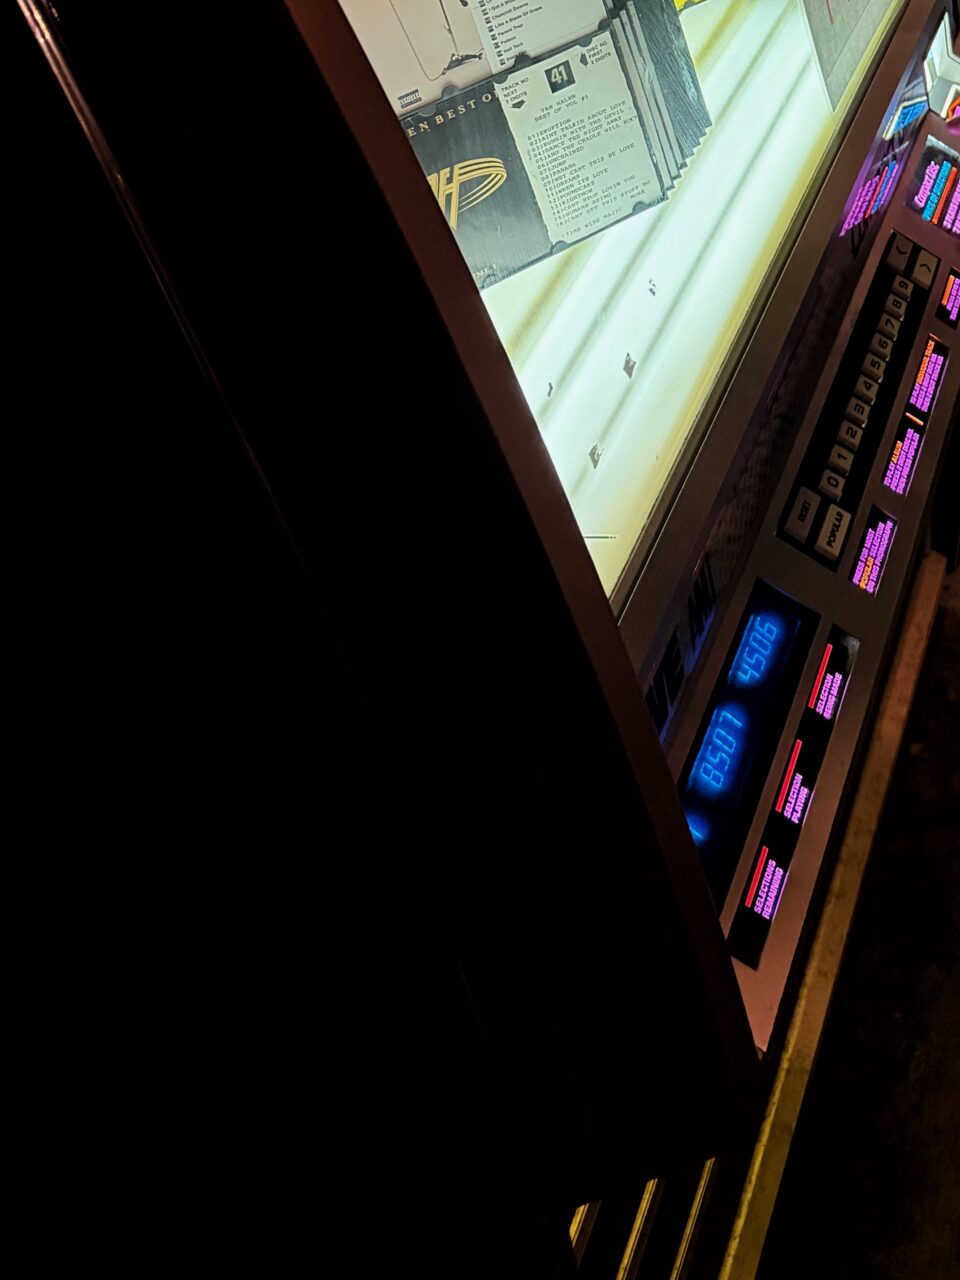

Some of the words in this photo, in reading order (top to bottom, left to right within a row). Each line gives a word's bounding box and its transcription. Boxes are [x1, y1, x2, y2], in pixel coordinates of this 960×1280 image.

[586, 44, 598, 54] DISC
[588, 49, 603, 59] FIRST
[594, 51, 611, 62] DIGITS
[548, 64, 568, 86] 41
[502, 88, 517, 98] NEXT
[508, 90, 527, 102] DIGITS
[433, 98, 478, 124] BEST
[534, 111, 551, 122] BEST
[553, 106, 561, 114] OF
[565, 99, 578, 108] VOL
[539, 104, 553, 113] VAN
[555, 93, 576, 106] HALEN
[898, 279, 908, 290] 9
[891, 298, 901, 309] 8
[884, 317, 895, 330] 7
[878, 337, 888, 350] 6
[869, 357, 880, 370] 5
[861, 378, 873, 392] 4
[853, 401, 865, 416] 3
[845, 424, 857, 439] 2
[837, 451, 847, 463] 1
[890, 440, 903, 463] ALBUM
[886, 461, 896, 477] PLAY
[895, 476, 907, 494] THEN
[901, 458, 912, 478] PRESS
[907, 432, 921, 460] POPULAR
[826, 473, 839, 489] 0
[883, 476, 891, 486] TO
[889, 469, 901, 491] PRESS
[797, 498, 811, 524] RESET
[826, 510, 844, 548] POPULAR
[863, 527, 875, 548] MOST
[874, 520, 893, 566] PHONOGRAPH
[858, 555, 874, 590] POPULAR
[869, 521, 885, 557] SELECTION
[859, 547, 869, 562] FOR
[852, 560, 865, 585] PRESS
[869, 564, 880, 581] THIS
[865, 579, 875, 593] ON
[815, 673, 833, 715] SELECTION
[822, 693, 835, 720] BEING
[830, 672, 841, 696] MADE
[783, 773, 802, 819] SELECTION
[790, 785, 807, 824] PLAYING
[753, 858, 776, 914] SELECTIONS
[761, 865, 782, 920] REMAINING
